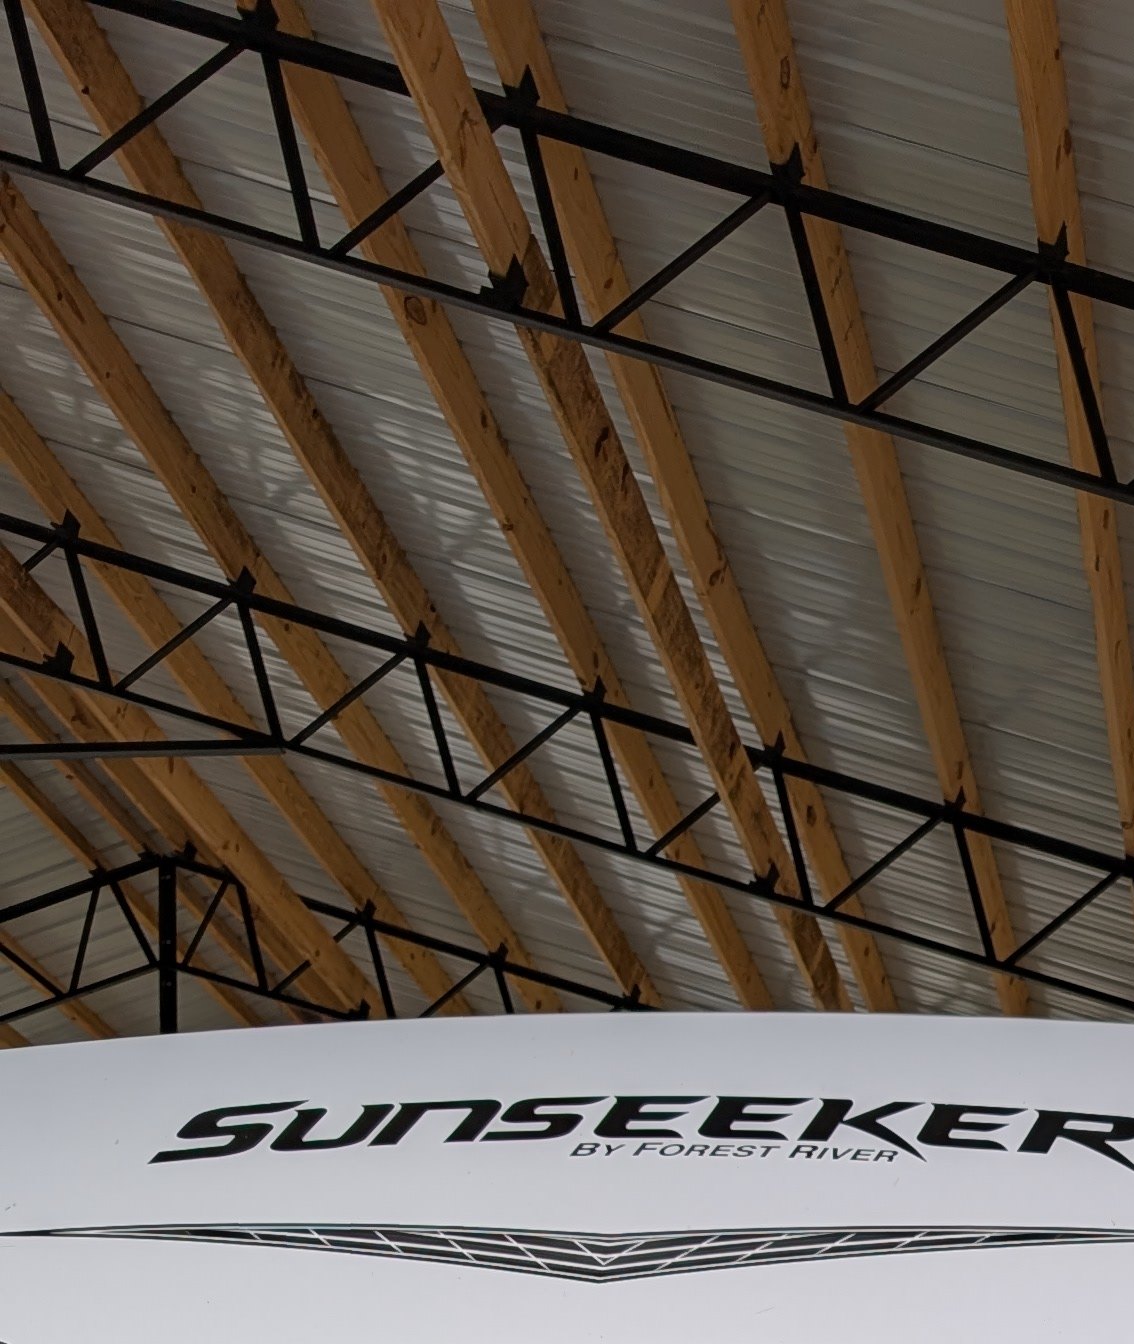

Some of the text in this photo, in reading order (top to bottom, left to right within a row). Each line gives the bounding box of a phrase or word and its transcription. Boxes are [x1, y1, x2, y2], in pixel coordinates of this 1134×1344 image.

[569, 1142, 899, 1162] BY FOREST RIVER
